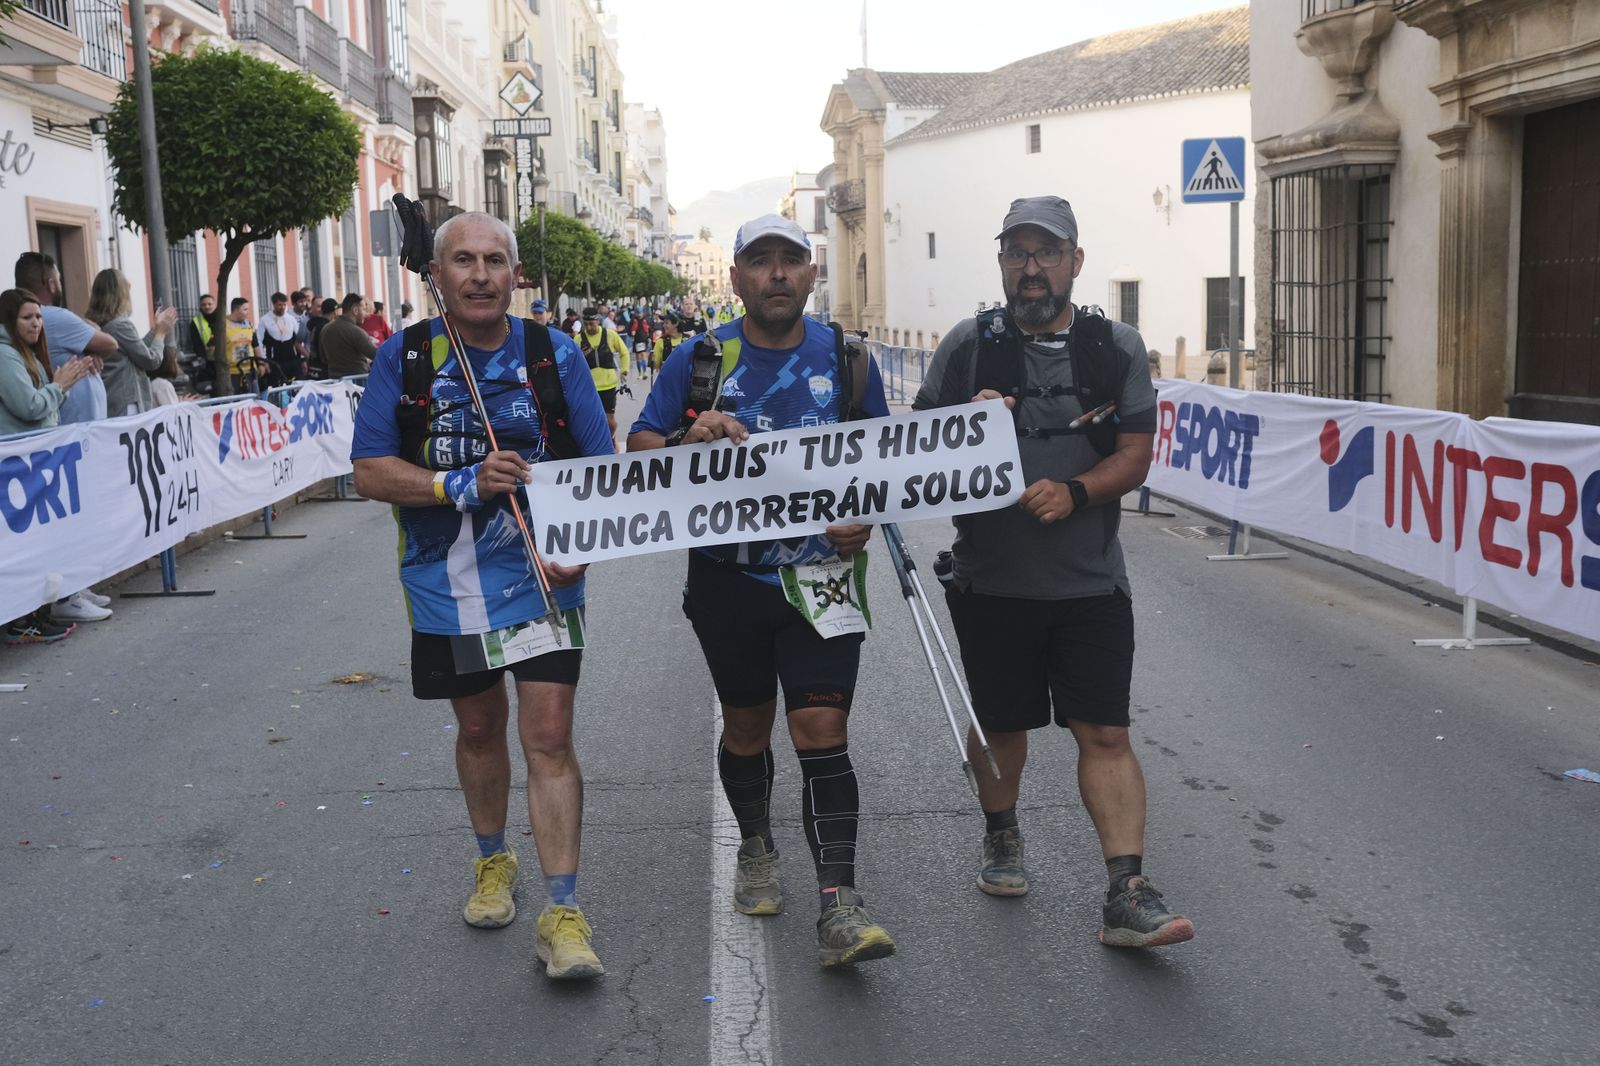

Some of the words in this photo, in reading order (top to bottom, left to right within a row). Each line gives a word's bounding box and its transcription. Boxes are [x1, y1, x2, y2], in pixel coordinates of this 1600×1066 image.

[272, 456, 294, 487] CARY
[556, 456, 673, 501] "JUAN
[688, 440, 787, 485] LUIS"
[799, 429, 866, 470] TUS
[878, 411, 988, 459] HIJOS
[1153, 400, 1260, 489] RSPORT
[168, 469, 199, 526] 24H
[545, 511, 673, 554] NUNCA
[687, 476, 888, 537] CORRERÁN
[901, 462, 1014, 509] SOLOS
